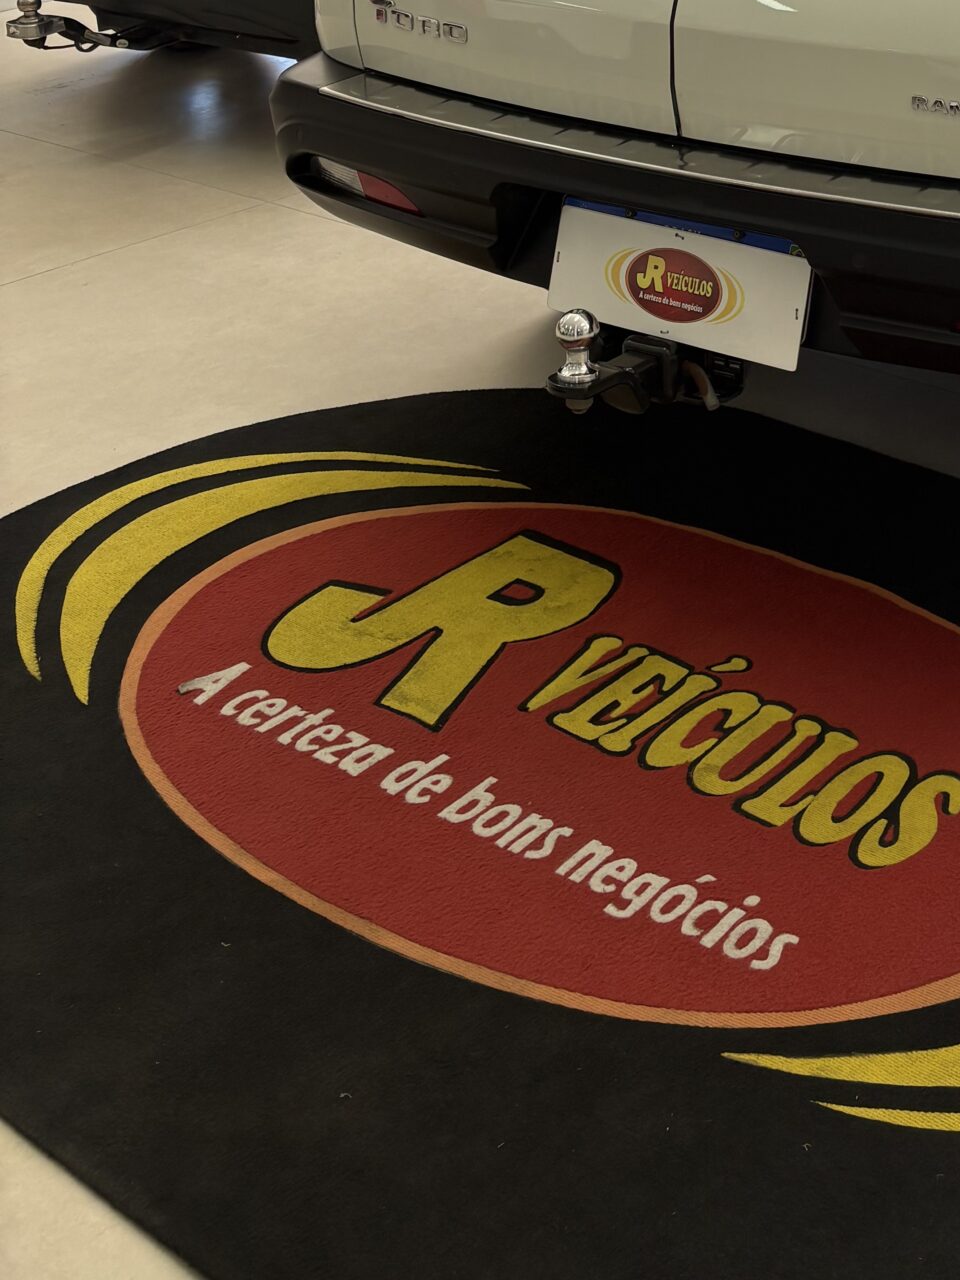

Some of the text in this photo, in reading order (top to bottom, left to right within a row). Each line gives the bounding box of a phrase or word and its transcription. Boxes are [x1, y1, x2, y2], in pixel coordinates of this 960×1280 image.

[636, 255, 713, 298] JR VEÍCULOS
[639, 291, 644, 300] A
[260, 530, 622, 733] JR
[178, 662, 800, 972] A certeza de bons negócios
